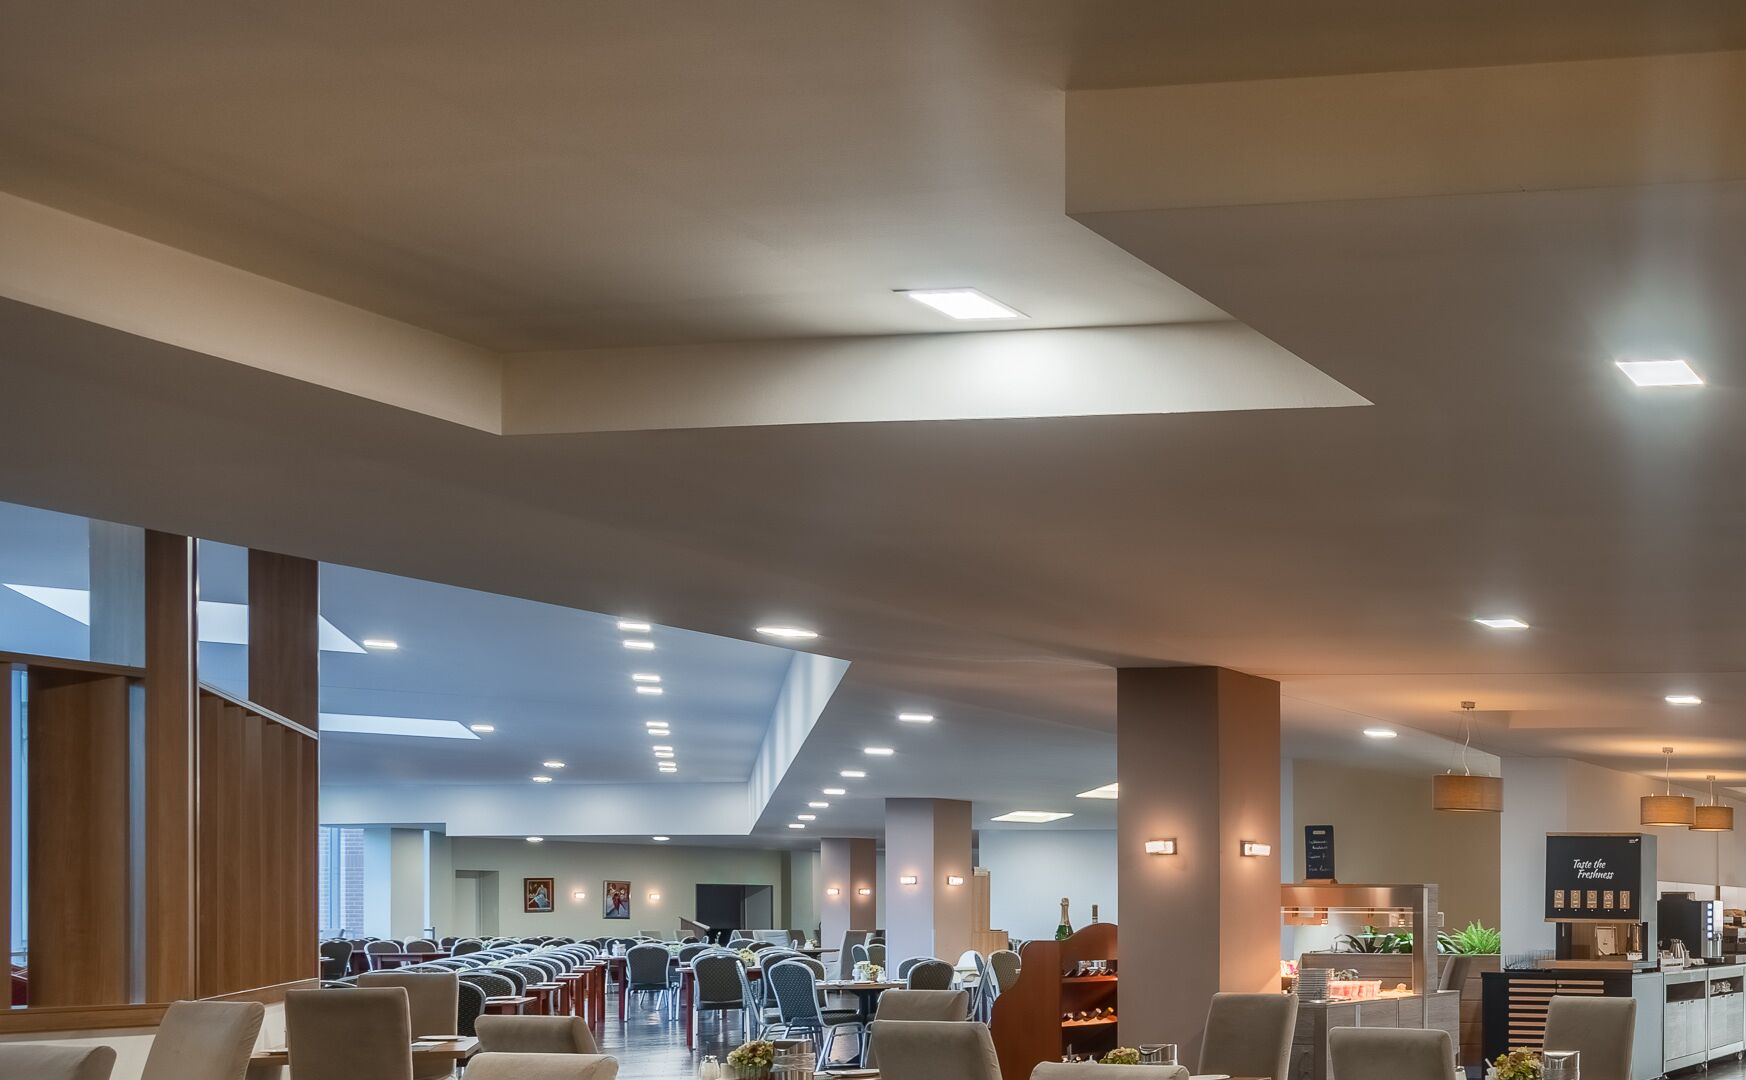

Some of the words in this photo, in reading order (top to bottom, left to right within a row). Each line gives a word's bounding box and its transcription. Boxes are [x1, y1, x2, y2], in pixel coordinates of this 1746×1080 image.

[1573, 858, 1593, 869] Taste
[1593, 858, 1606, 869] the
[1577, 868, 1614, 879] Freshness
